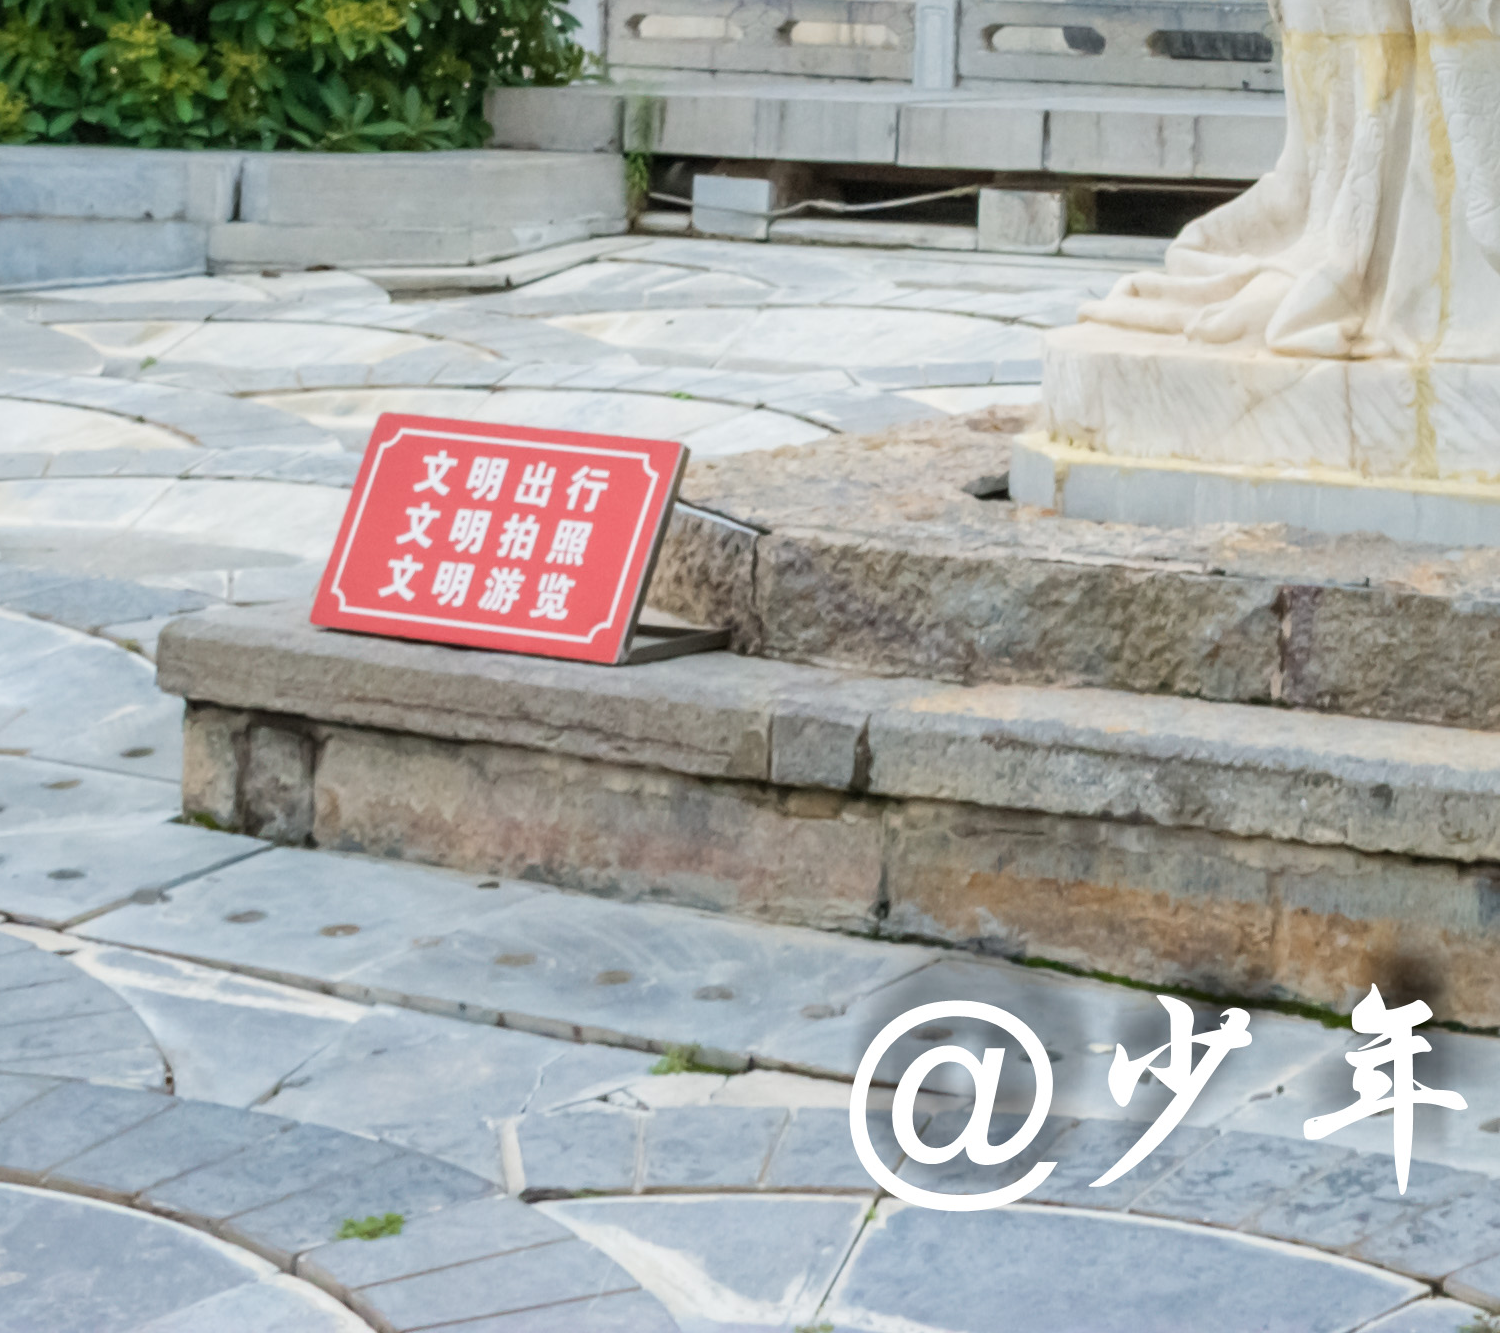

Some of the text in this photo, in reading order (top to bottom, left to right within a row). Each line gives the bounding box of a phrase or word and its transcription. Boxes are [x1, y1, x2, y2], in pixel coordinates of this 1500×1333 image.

[412, 450, 610, 513] 文明出行
[396, 501, 594, 566] 文明拍照
[378, 554, 576, 621] 文明游览
